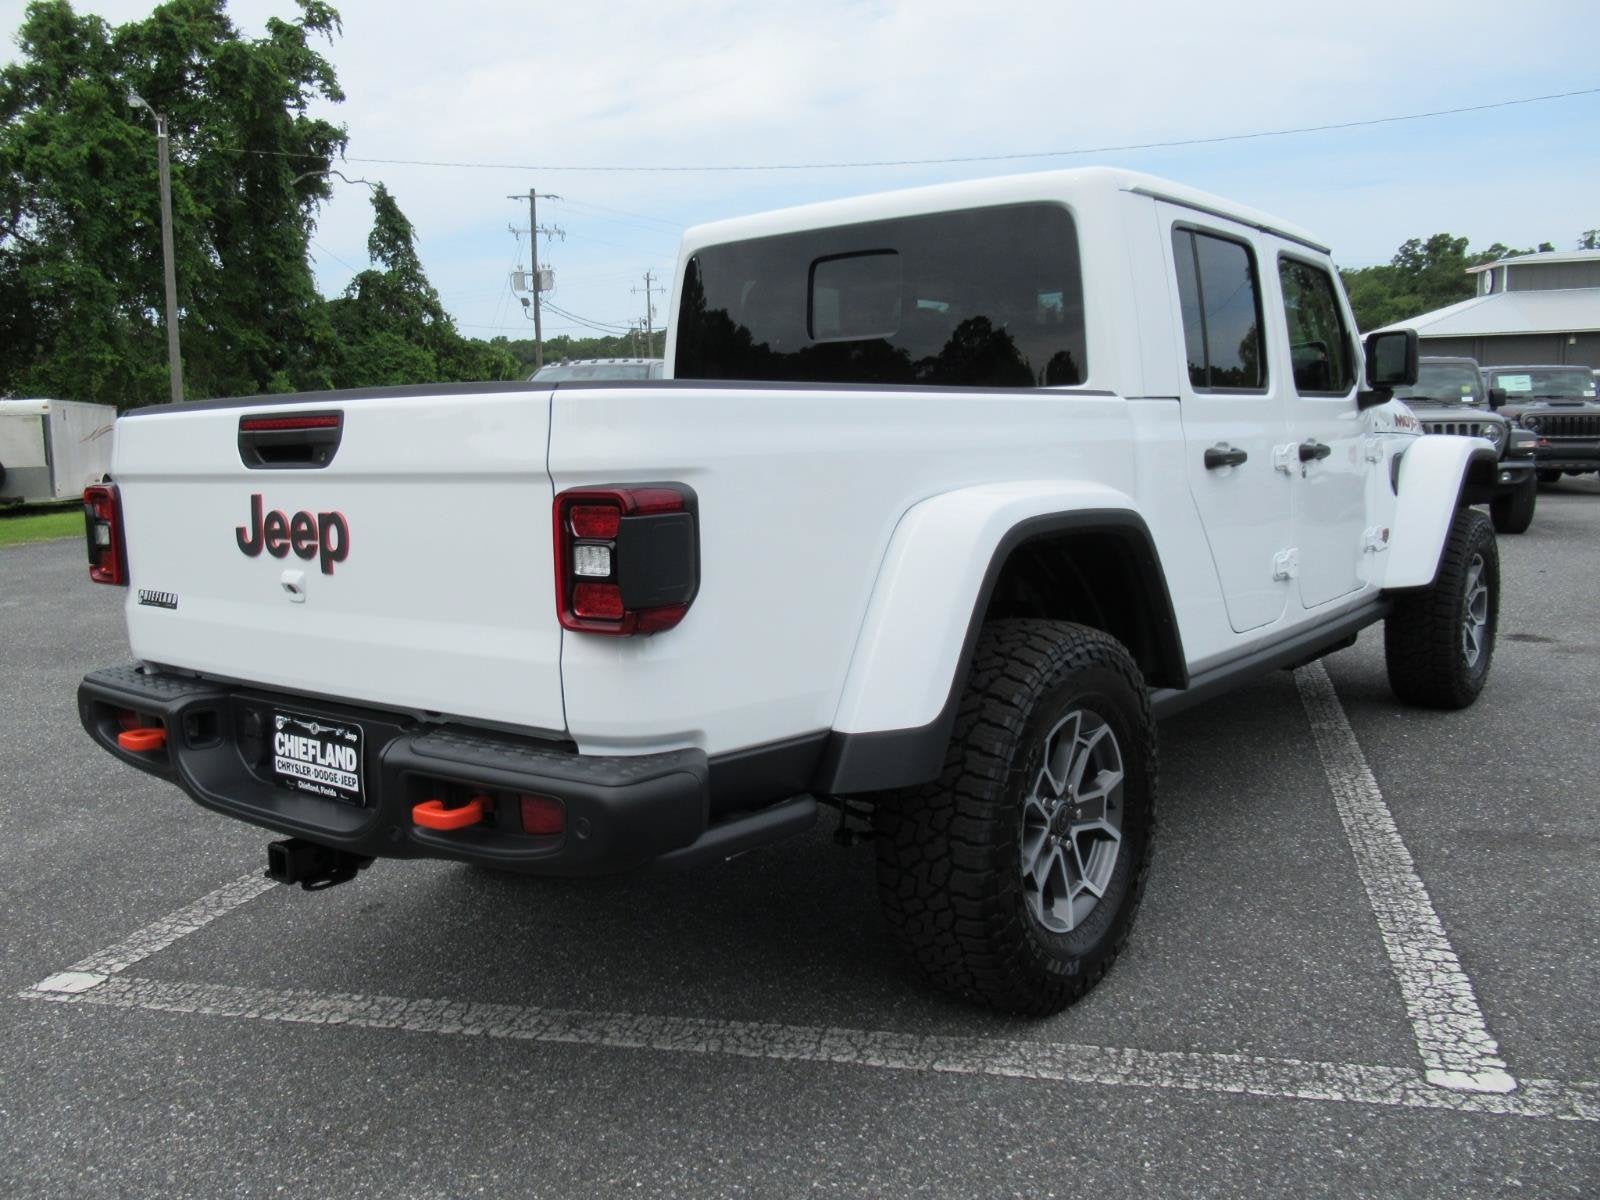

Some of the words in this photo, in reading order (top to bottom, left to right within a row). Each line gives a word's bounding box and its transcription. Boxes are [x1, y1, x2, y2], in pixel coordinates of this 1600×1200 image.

[235, 494, 350, 576] Jeep
[138, 589, 178, 605] CHIEFLAND
[275, 732, 357, 771] CHIEFLAND
